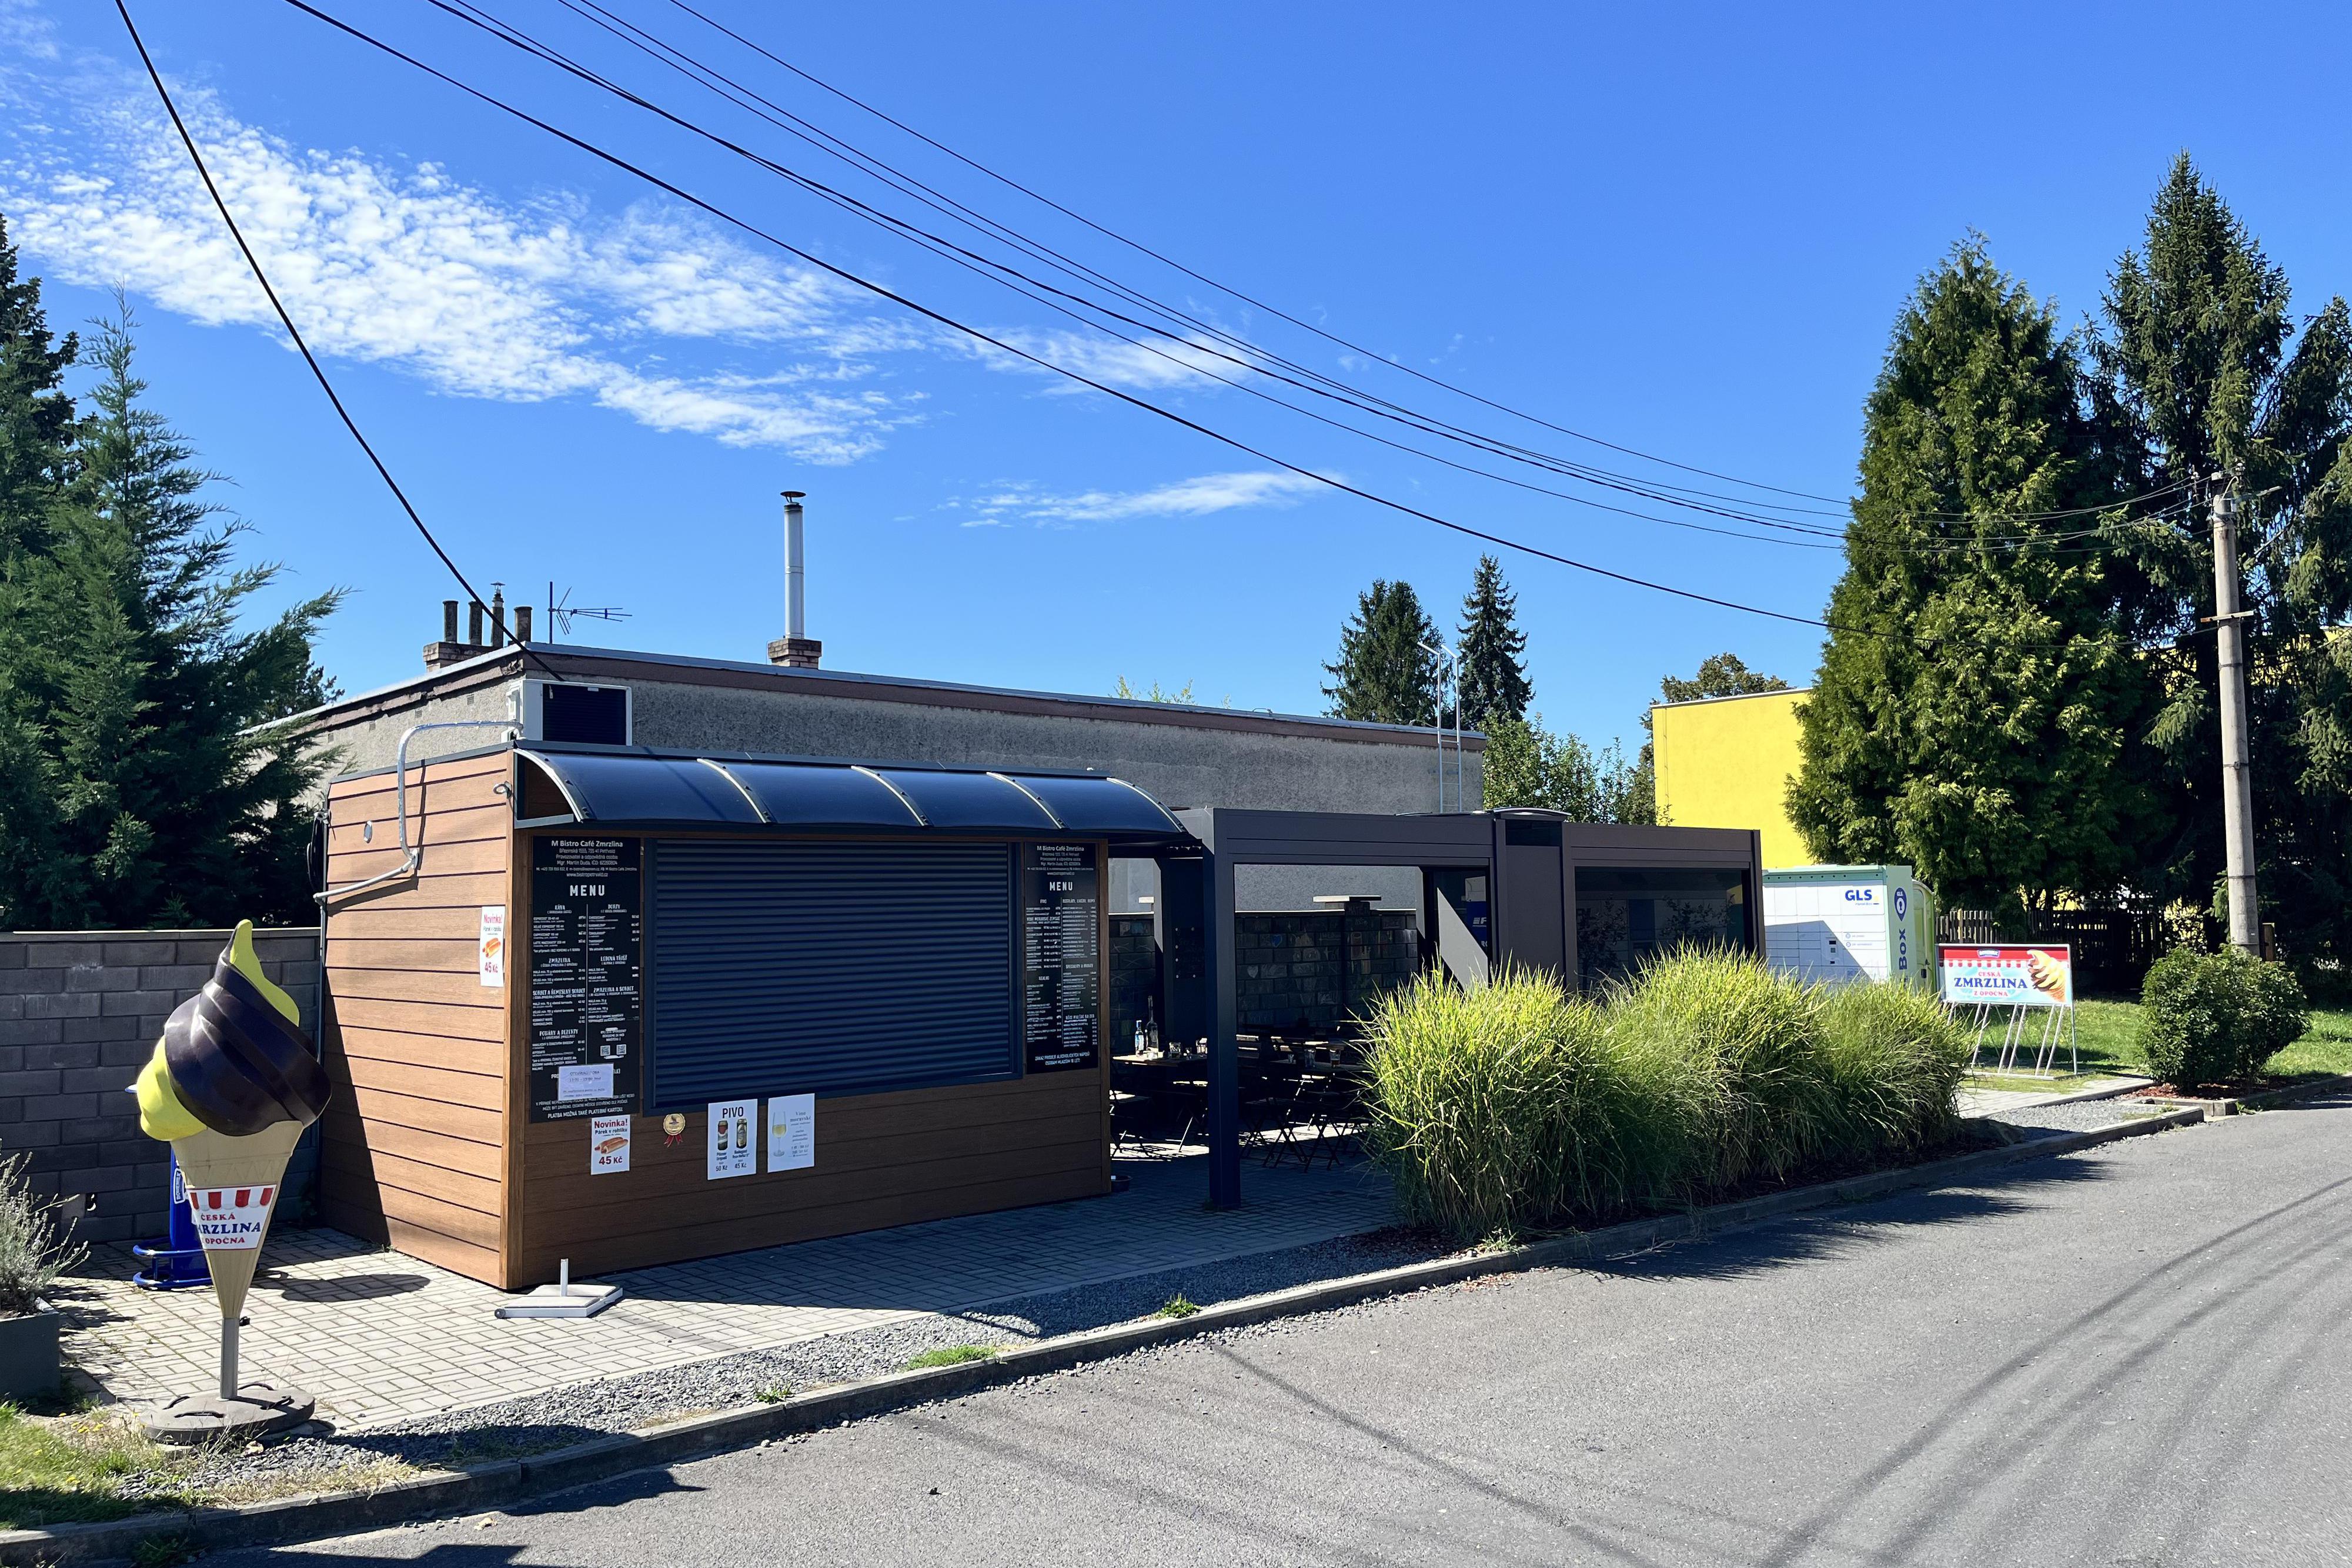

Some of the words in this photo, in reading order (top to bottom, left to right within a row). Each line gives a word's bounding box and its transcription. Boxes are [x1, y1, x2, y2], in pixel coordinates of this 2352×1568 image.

[570, 885, 605, 896] MENU
[1050, 882, 1073, 891] MENU
[1845, 889, 1872, 901] GLS
[484, 914, 502, 924] Novinka!
[485, 962, 492, 973] 45
[493, 964, 498, 972] Kč
[1954, 978, 2027, 988] ZMRZLINA
[722, 1106, 744, 1118] PIVO
[594, 1118, 627, 1128] Novinka!
[599, 1156, 612, 1165] 45
[613, 1156, 623, 1164] Kč
[201, 1212, 236, 1221] ČESKÁ
